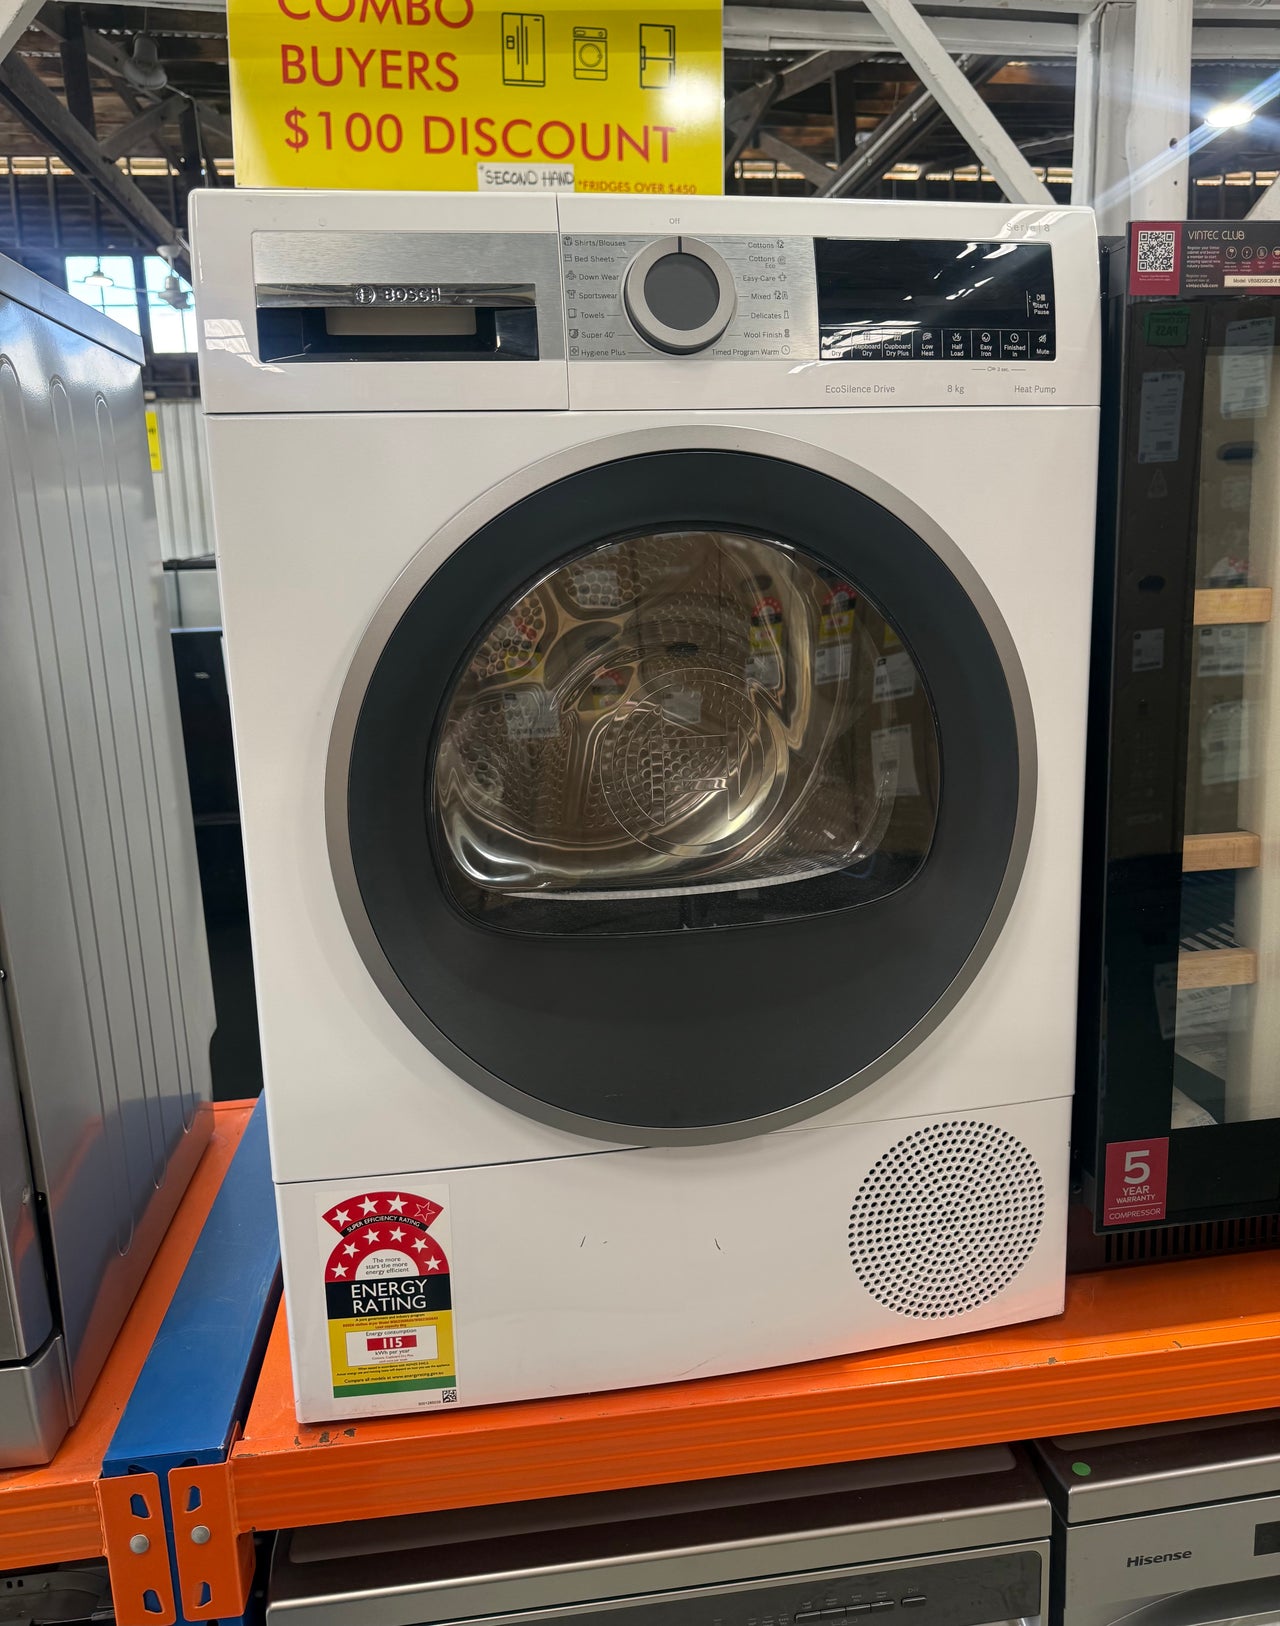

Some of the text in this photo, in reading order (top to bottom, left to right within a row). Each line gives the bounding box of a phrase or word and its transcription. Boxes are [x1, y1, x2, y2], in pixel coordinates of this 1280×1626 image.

[278, 0, 474, 29] COMBO
[281, 44, 459, 92] BUYERS
[284, 106, 677, 164] $100 DISCOUNT
[542, 170, 575, 187] HAND
[634, 182, 664, 194] OVER
[1044, 224, 1050, 232] 8
[1188, 230, 1245, 240] VINTEC CLUB
[574, 239, 626, 247] Shirts/Blouses
[382, 287, 440, 302] BOSCH
[750, 312, 782, 320] Delicates
[732, 348, 760, 357] Program
[884, 344, 911, 352] Cupboard
[980, 344, 992, 352] Easy
[582, 350, 609, 358] Hygiene
[825, 384, 895, 393] EcoSilence Drive
[954, 385, 964, 394] kg
[1034, 386, 1056, 394] Pump
[1124, 1150, 1150, 1184] 5
[1122, 1185, 1150, 1196] YEAR
[1116, 1194, 1156, 1204] WARRANTY
[1109, 1208, 1160, 1220] COMPRESSOR
[346, 1215, 420, 1232] SUPER EFFICIENCY RATING
[351, 1279, 428, 1298] ENERGY
[353, 1296, 426, 1314] RATING
[383, 1337, 402, 1348] 115
[1126, 1550, 1192, 1568] Hisense
